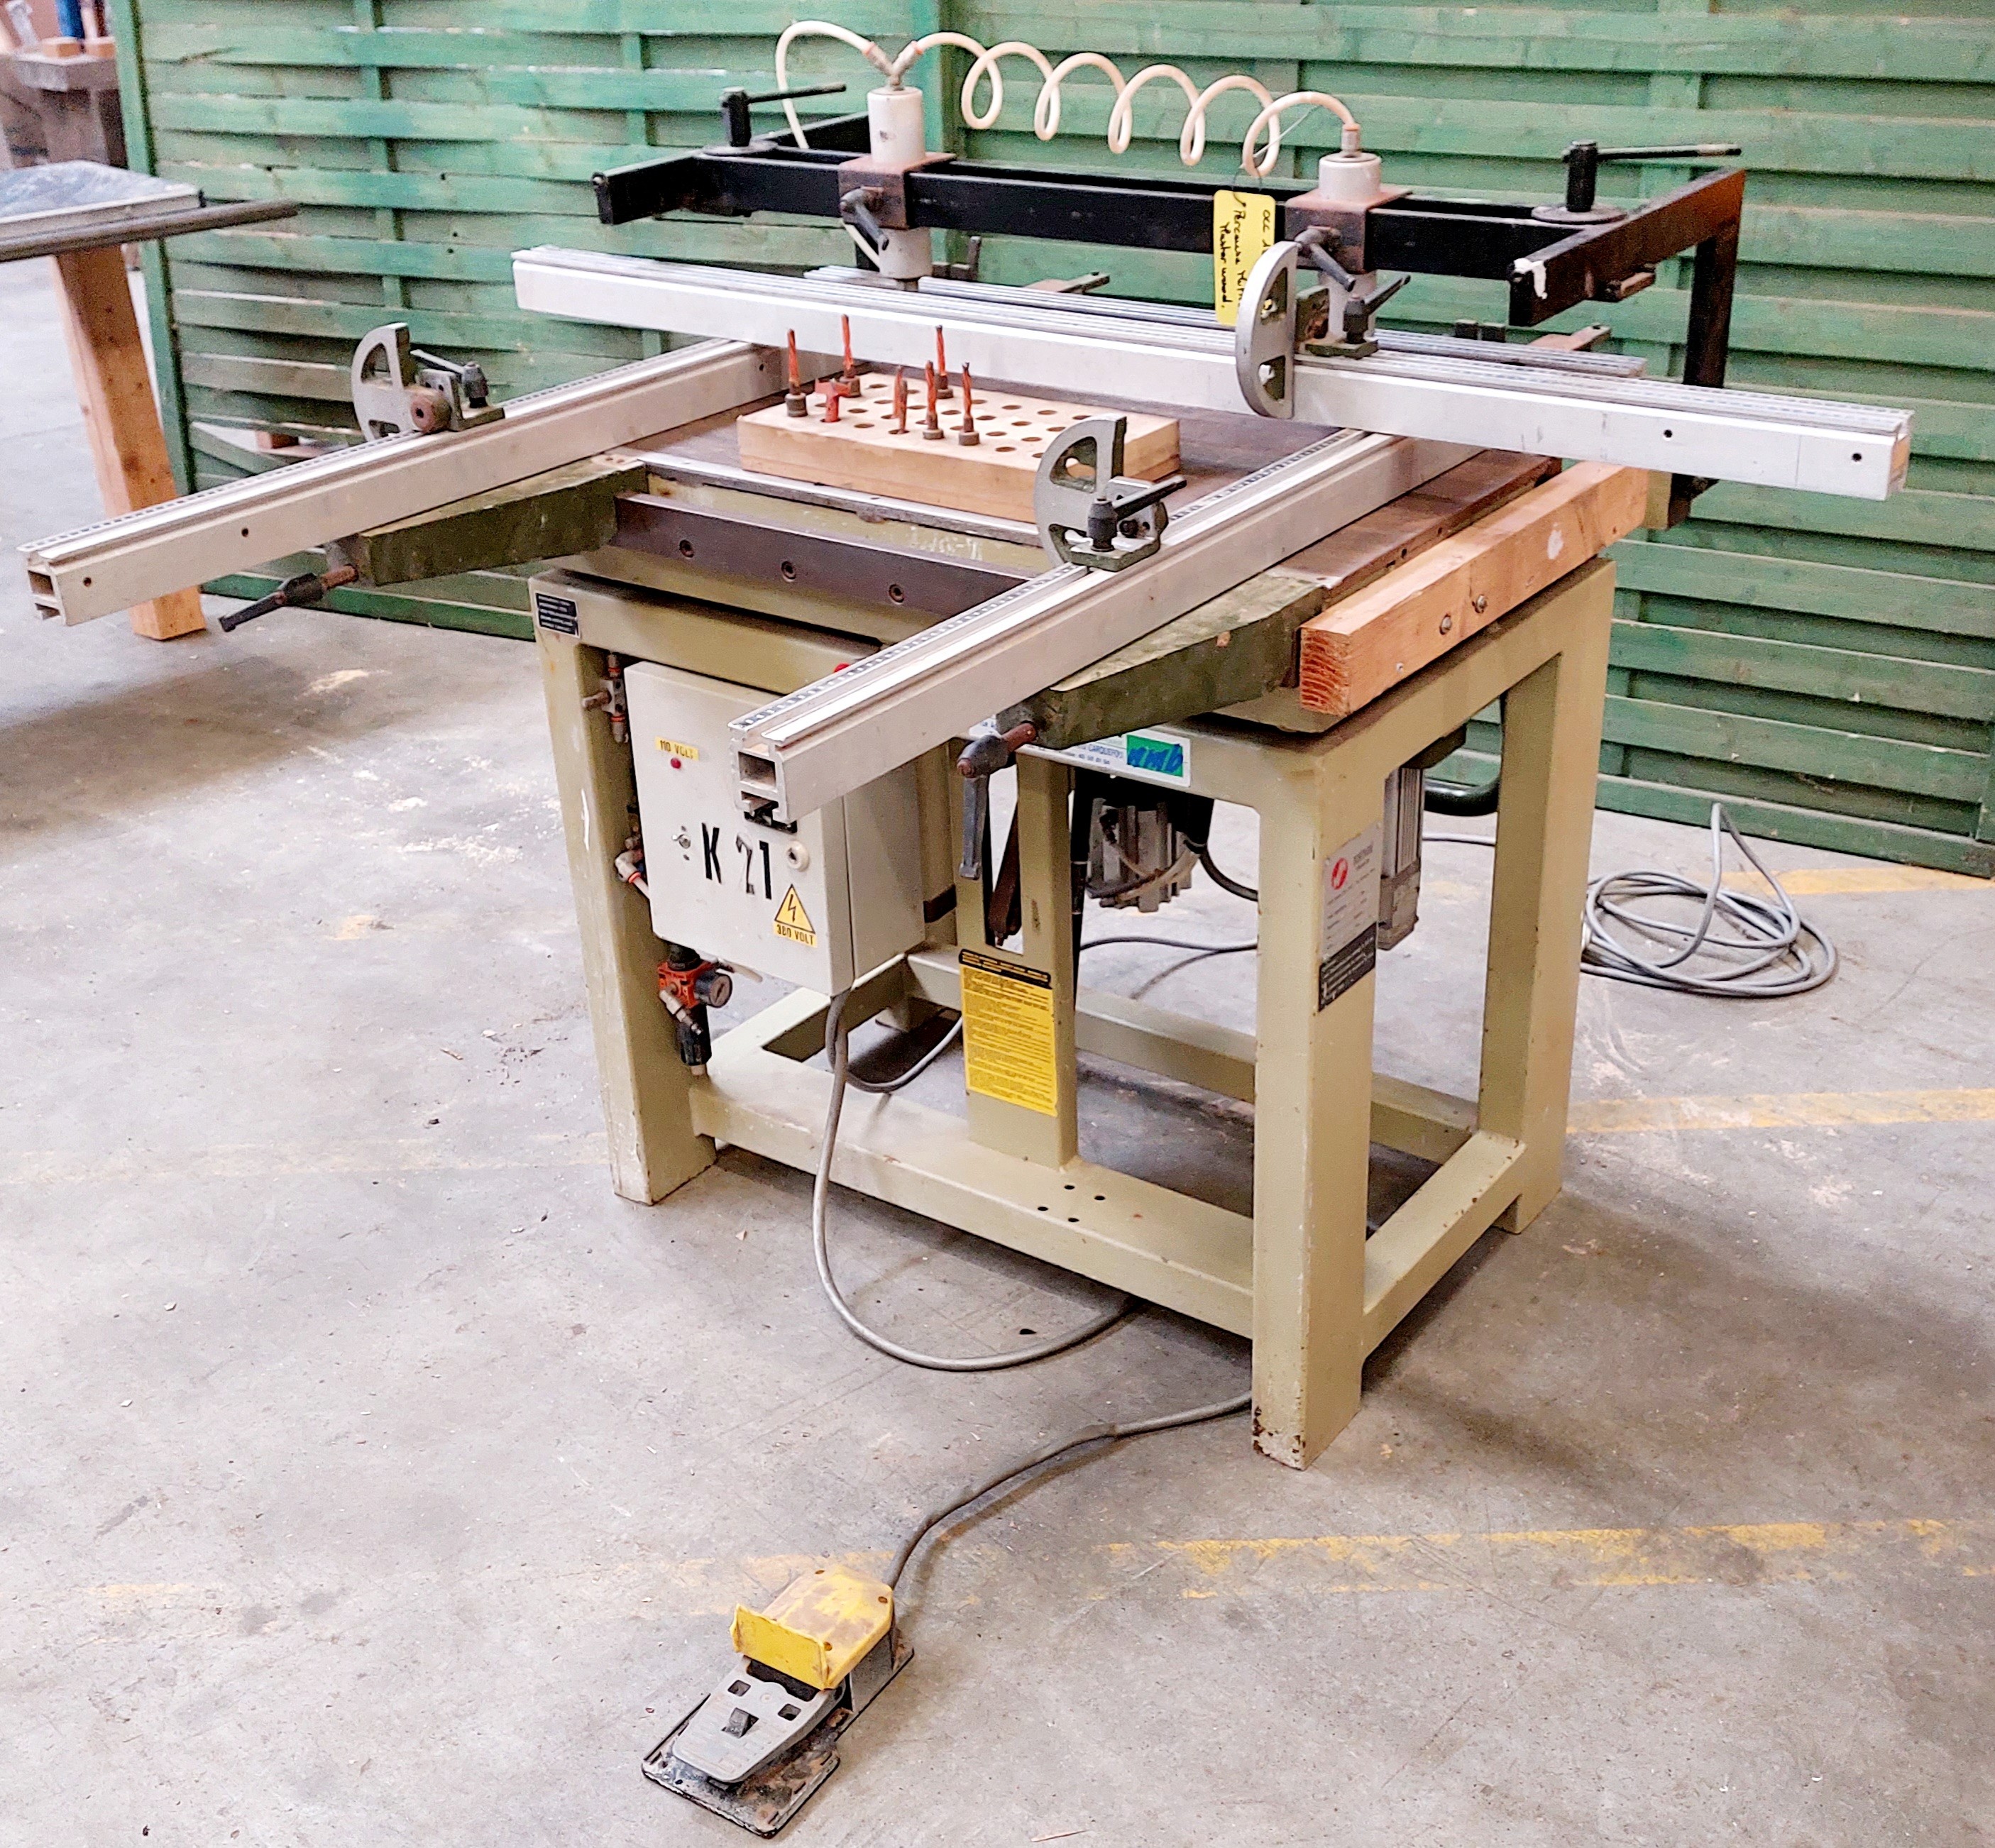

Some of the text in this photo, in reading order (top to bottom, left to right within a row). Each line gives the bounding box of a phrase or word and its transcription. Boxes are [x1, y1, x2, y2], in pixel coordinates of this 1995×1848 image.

[701, 823, 772, 900] K 21
[794, 930, 814, 945] VOLT
